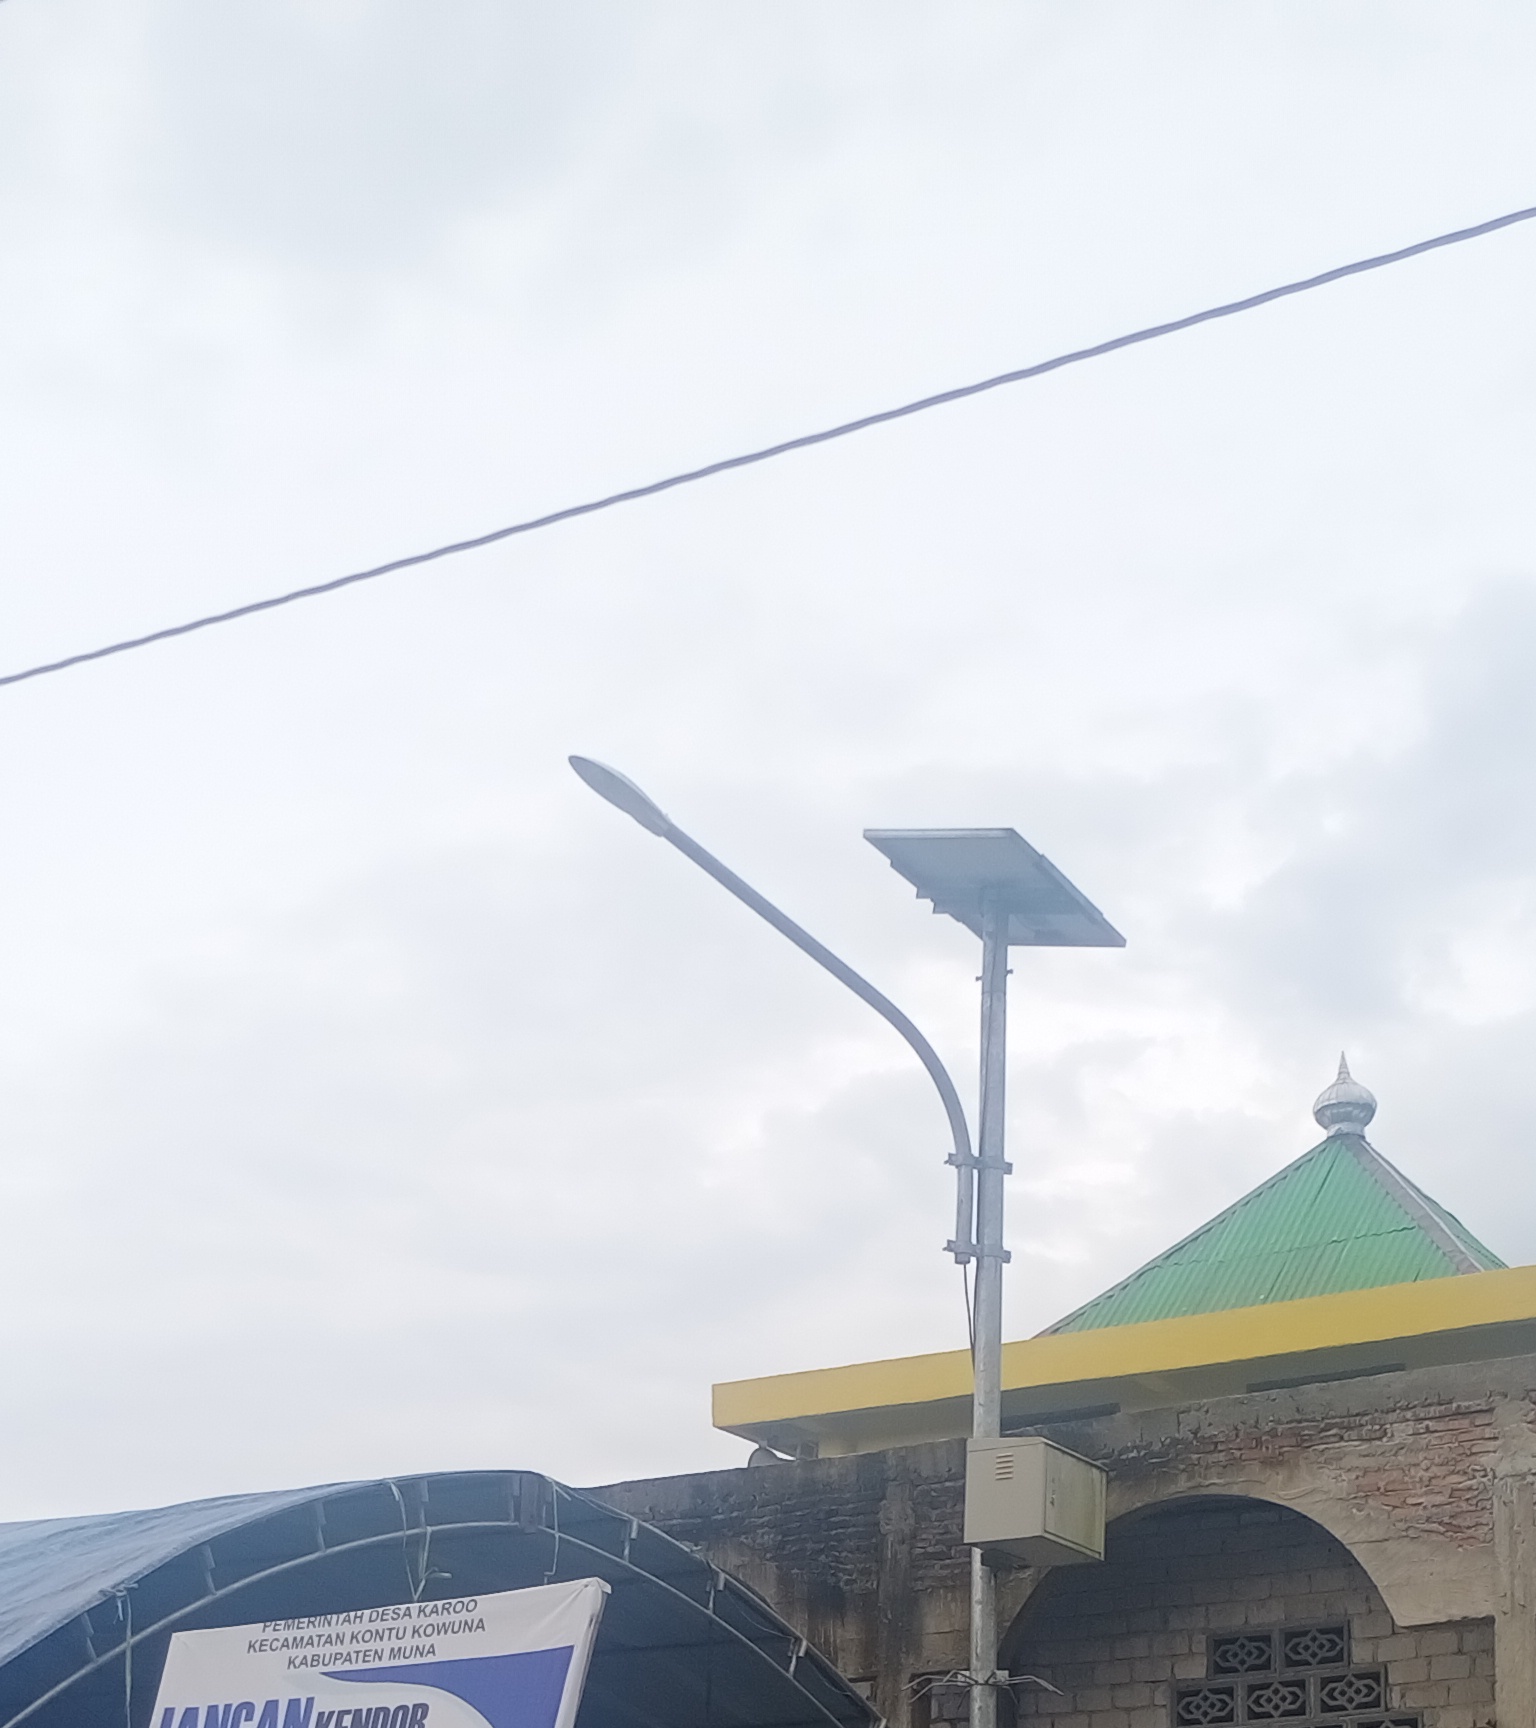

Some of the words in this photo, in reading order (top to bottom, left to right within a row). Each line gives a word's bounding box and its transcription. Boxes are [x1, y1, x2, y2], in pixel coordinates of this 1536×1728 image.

[262, 1611, 365, 1633] PEMERINTAH
[368, 1605, 413, 1624] DESA
[416, 1598, 478, 1619] KAROO
[247, 1631, 346, 1654] KECAMATAN
[349, 1626, 407, 1645] KONTU
[411, 1618, 486, 1639] KOWUNA
[286, 1648, 385, 1670] KABUPATEN
[388, 1643, 436, 1661] MUNA
